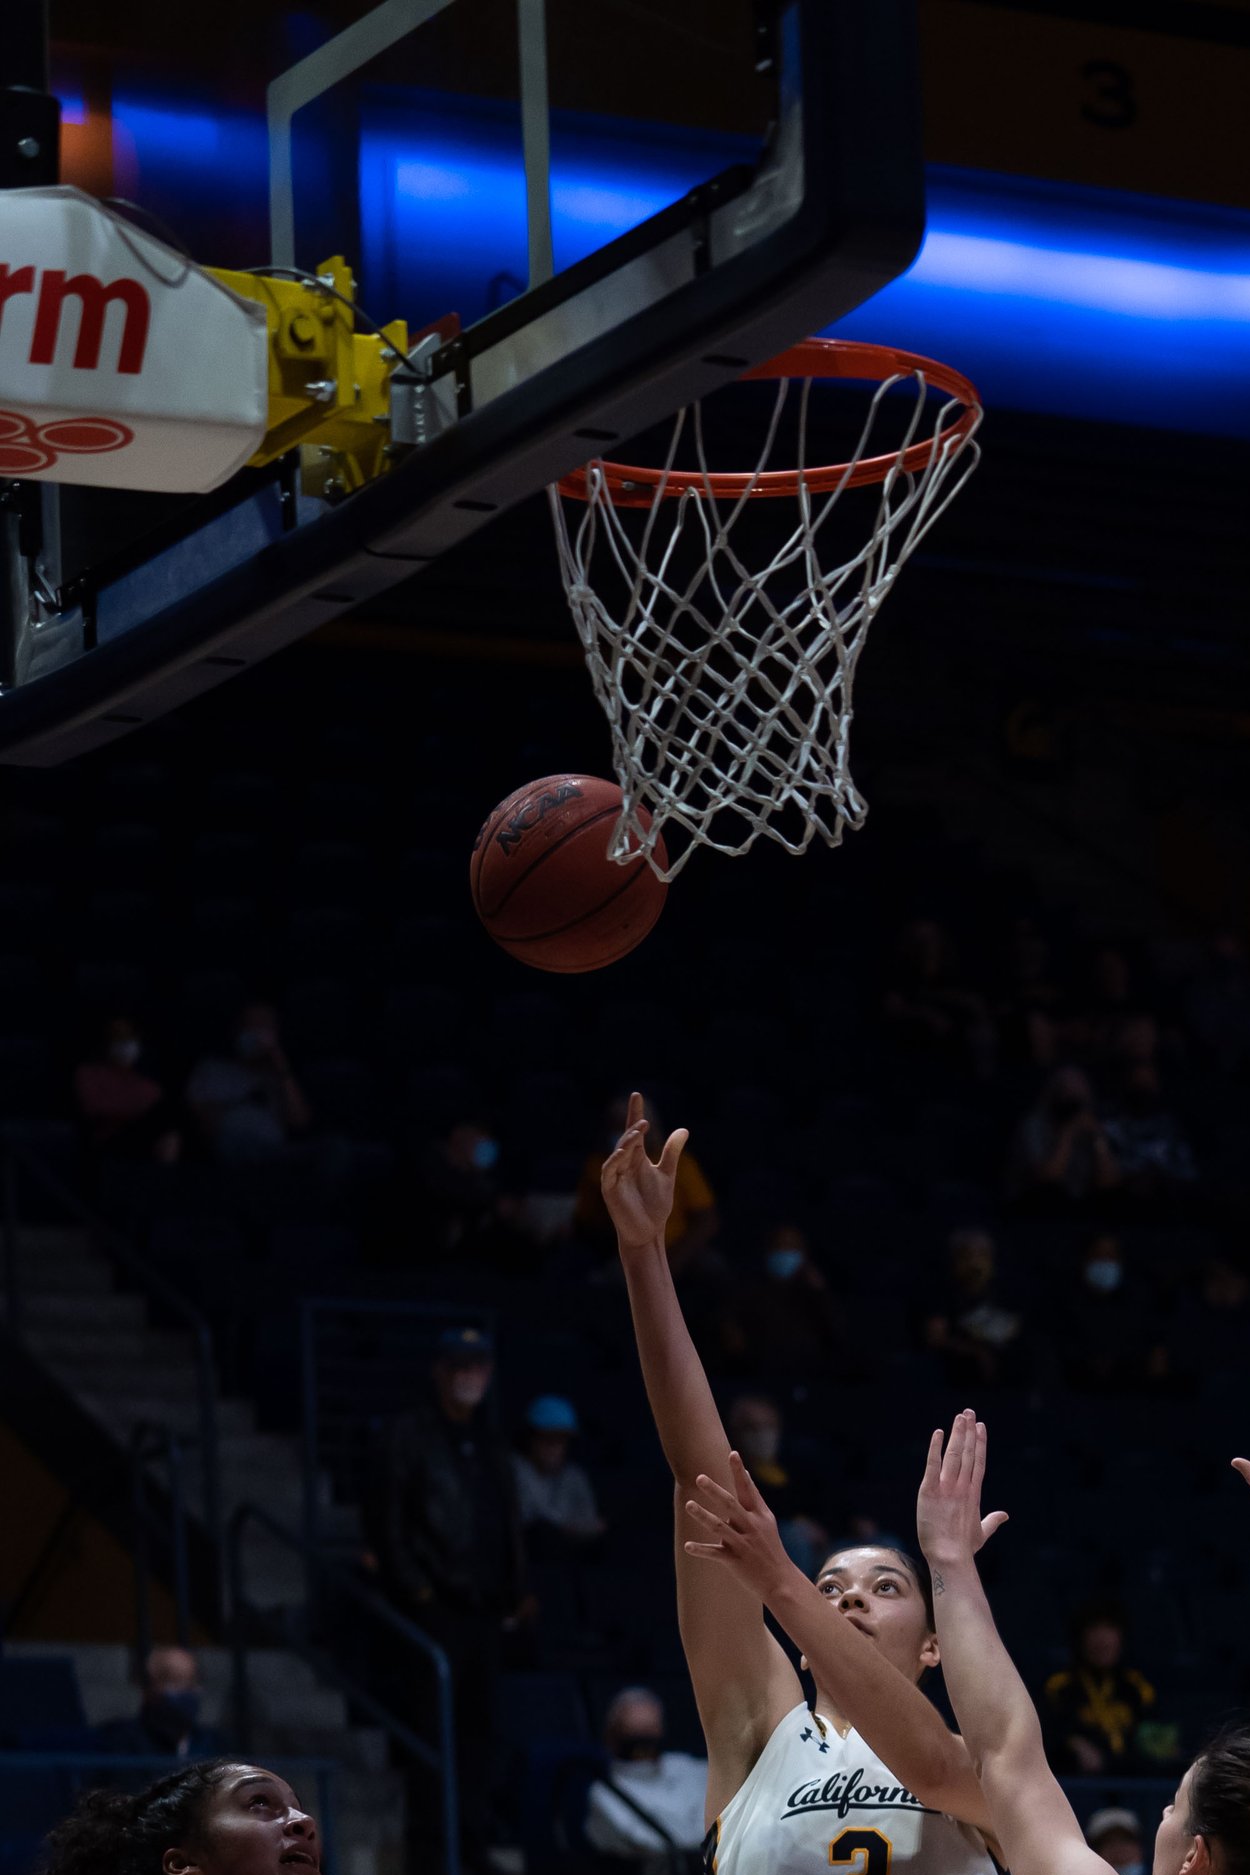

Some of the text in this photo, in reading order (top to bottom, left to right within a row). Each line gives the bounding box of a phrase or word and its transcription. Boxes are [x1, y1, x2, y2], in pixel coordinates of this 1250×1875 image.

[1082, 60, 1137, 128] 3
[496, 783, 584, 857] NCAA
[781, 1768, 936, 1820] Californ
